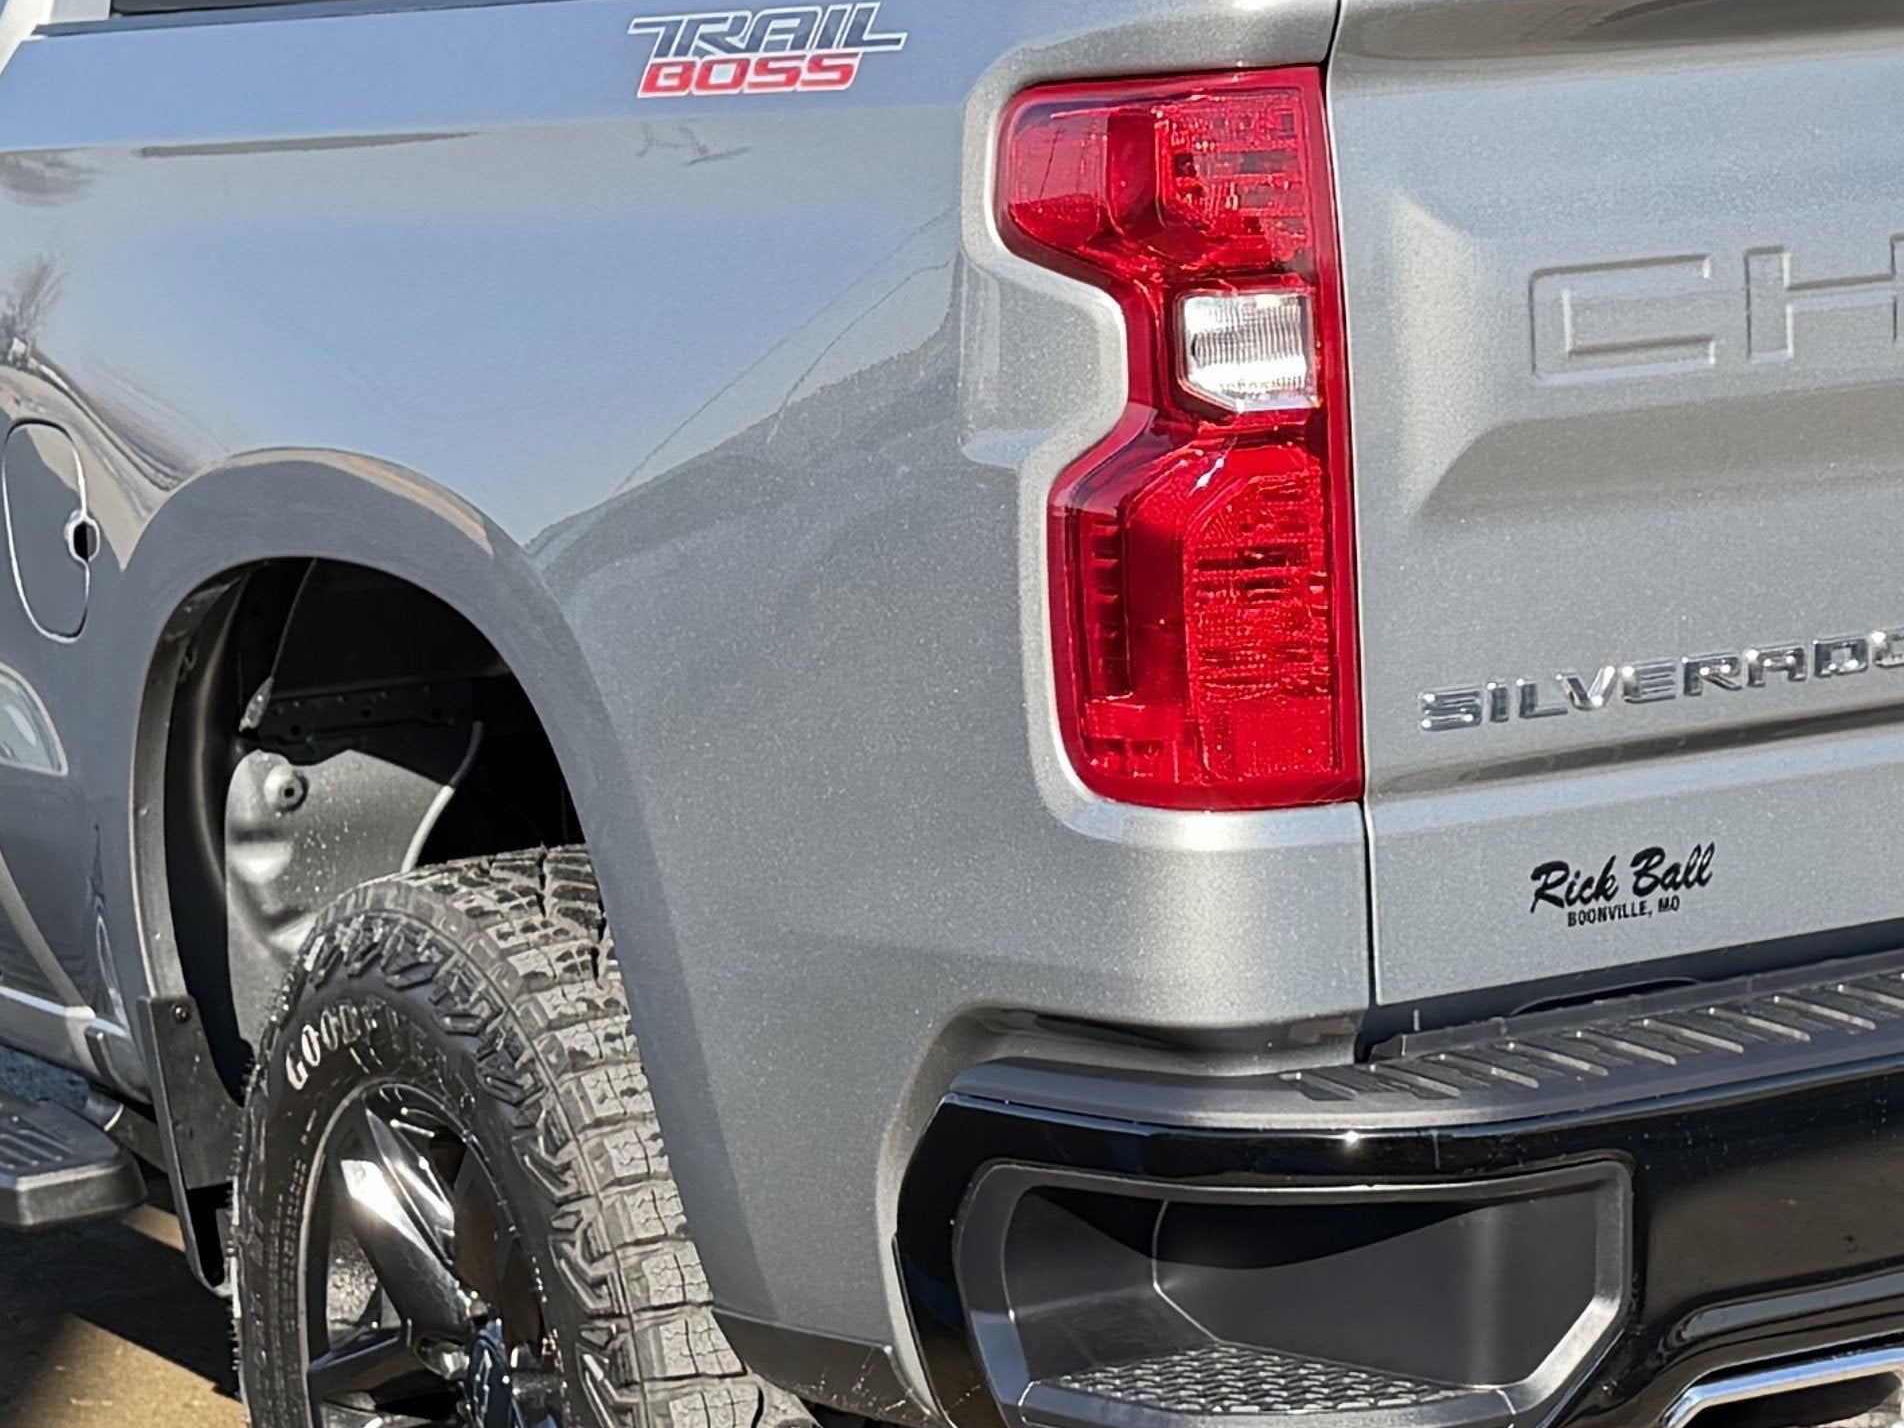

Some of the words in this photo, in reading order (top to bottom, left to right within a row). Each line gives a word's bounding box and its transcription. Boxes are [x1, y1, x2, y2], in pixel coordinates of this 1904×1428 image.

[627, 1, 908, 59] TRAIL
[637, 48, 864, 98] BOSS
[1530, 854, 1620, 915] Rick
[1629, 841, 1716, 898] Ball
[1566, 899, 1654, 928] BOONVILLE,
[1657, 894, 1681, 914] MO
